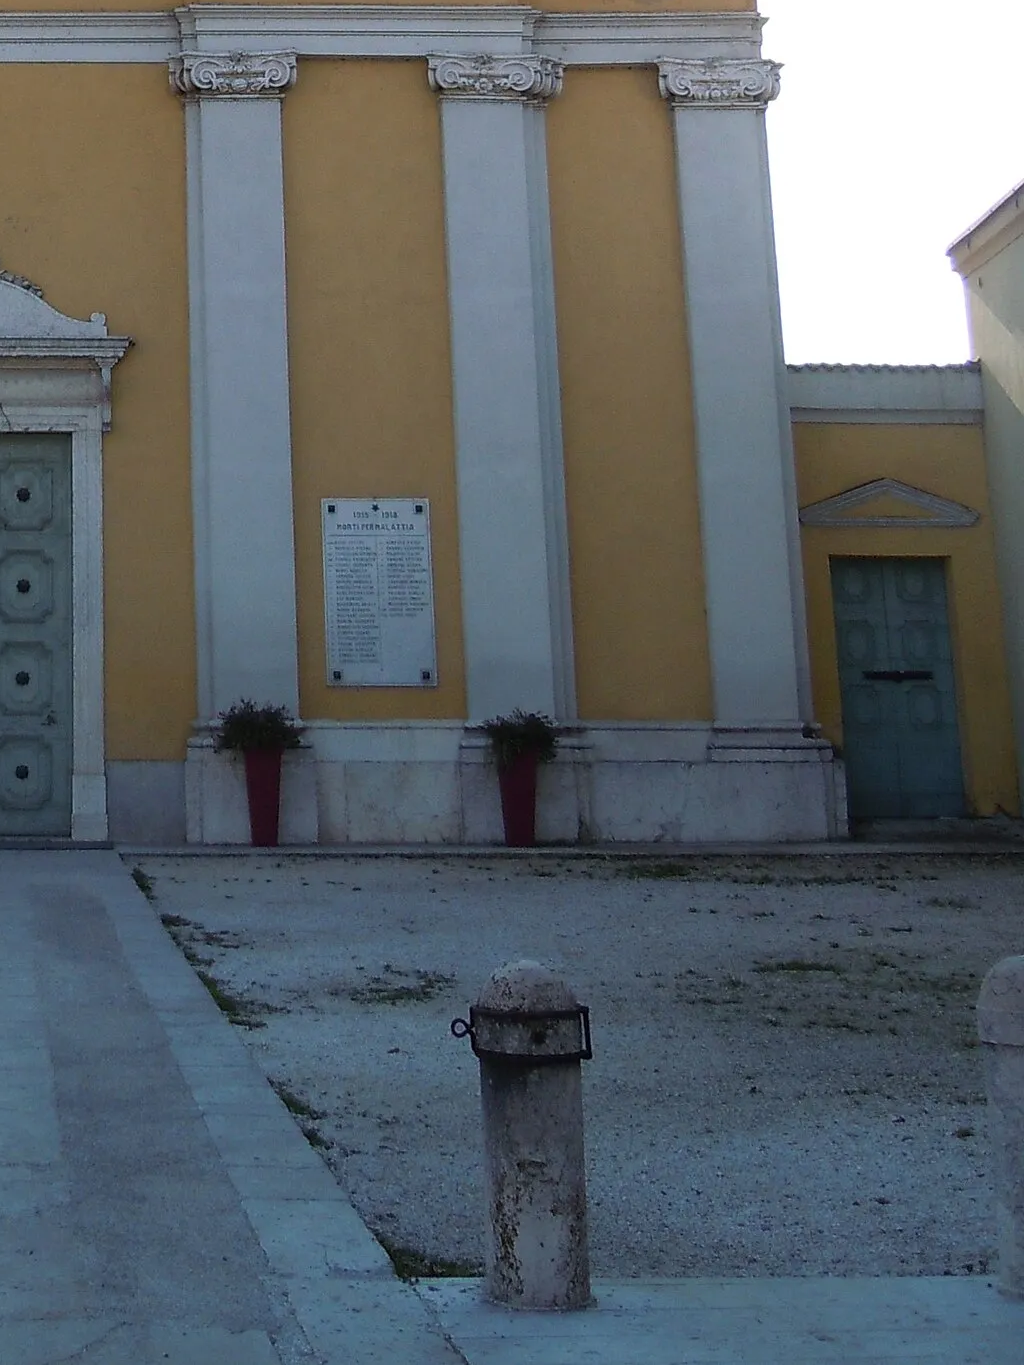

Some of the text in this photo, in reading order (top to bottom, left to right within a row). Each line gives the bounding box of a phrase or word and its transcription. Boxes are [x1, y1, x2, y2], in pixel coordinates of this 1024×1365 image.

[353, 511, 369, 519] 1915
[381, 511, 398, 519] 1918
[336, 523, 414, 531] MORTI PER MALATTIA
